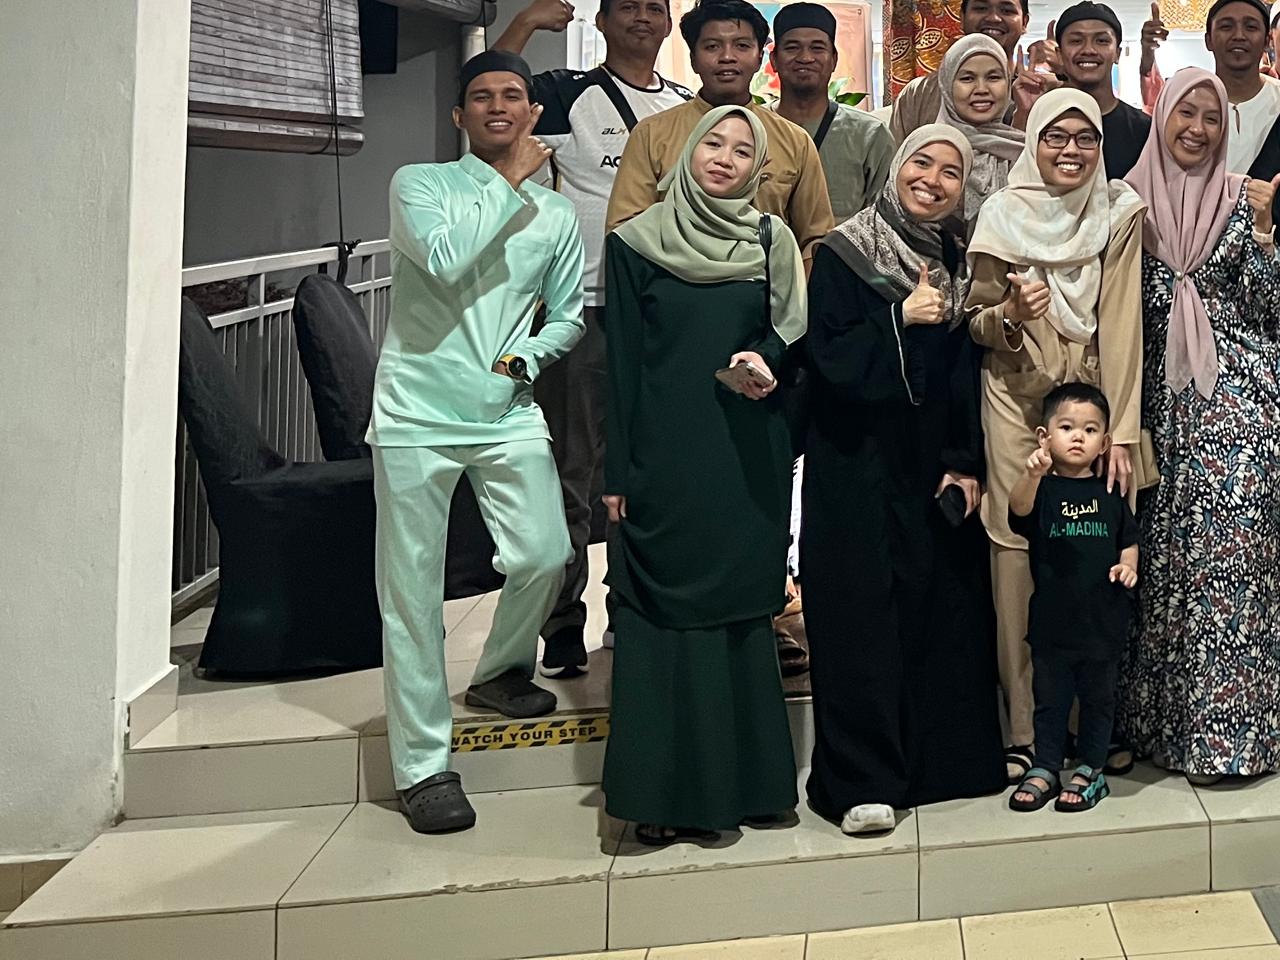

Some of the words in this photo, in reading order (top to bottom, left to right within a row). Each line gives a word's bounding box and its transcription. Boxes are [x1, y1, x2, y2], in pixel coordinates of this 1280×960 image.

[1061, 498, 1099, 520] المدينة
[1049, 521, 1109, 538] AL-MADINA
[509, 730, 553, 742] YOUR
[559, 726, 597, 738] STEP
